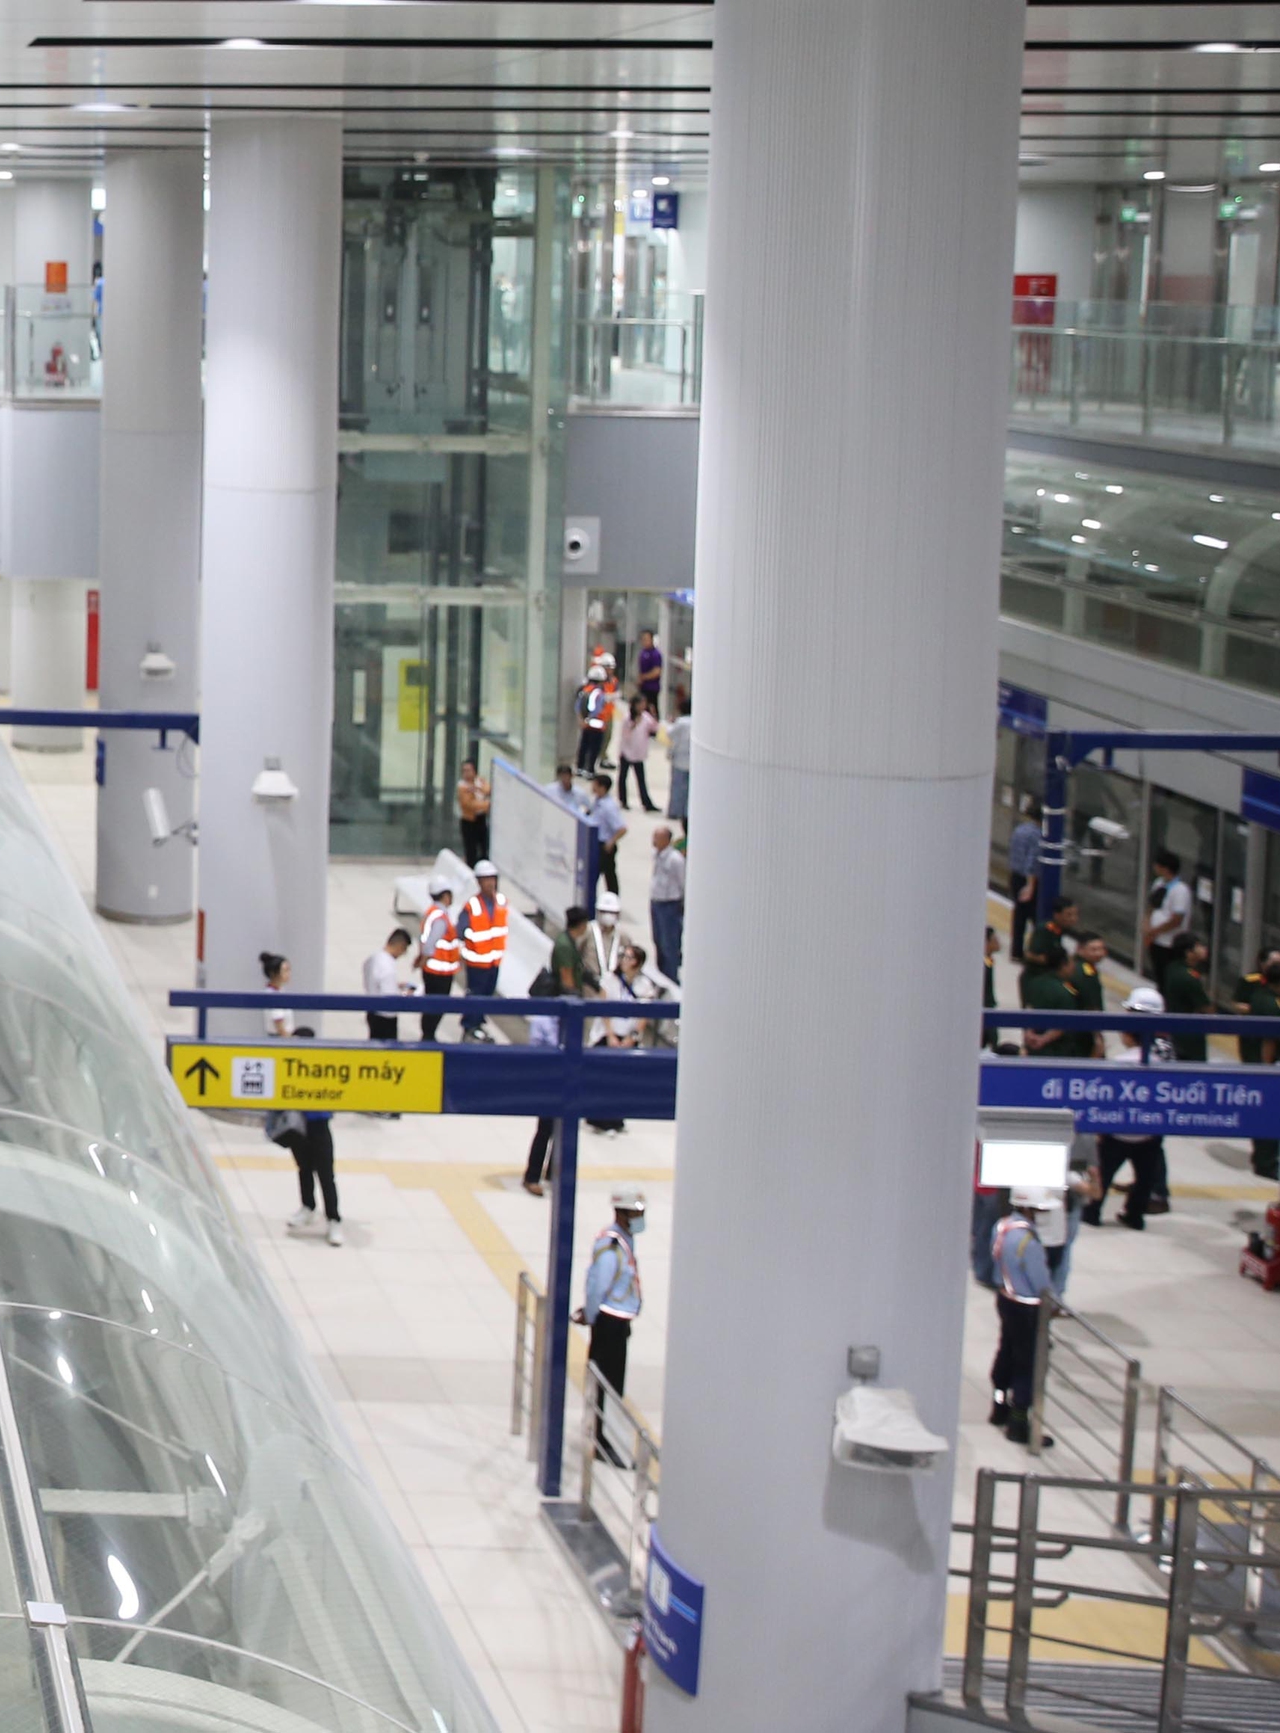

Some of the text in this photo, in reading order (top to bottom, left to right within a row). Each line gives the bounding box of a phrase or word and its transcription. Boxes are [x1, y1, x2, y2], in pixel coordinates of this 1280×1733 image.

[283, 1058, 406, 1085] Thang máy
[282, 1085, 344, 1100] Elevator
[1041, 1077, 1262, 1106] đi Bến Xe Suối Tiên
[1087, 1107, 1124, 1123] Suoi
[1128, 1107, 1163, 1125] Tien
[1166, 1109, 1239, 1127] Terminal
